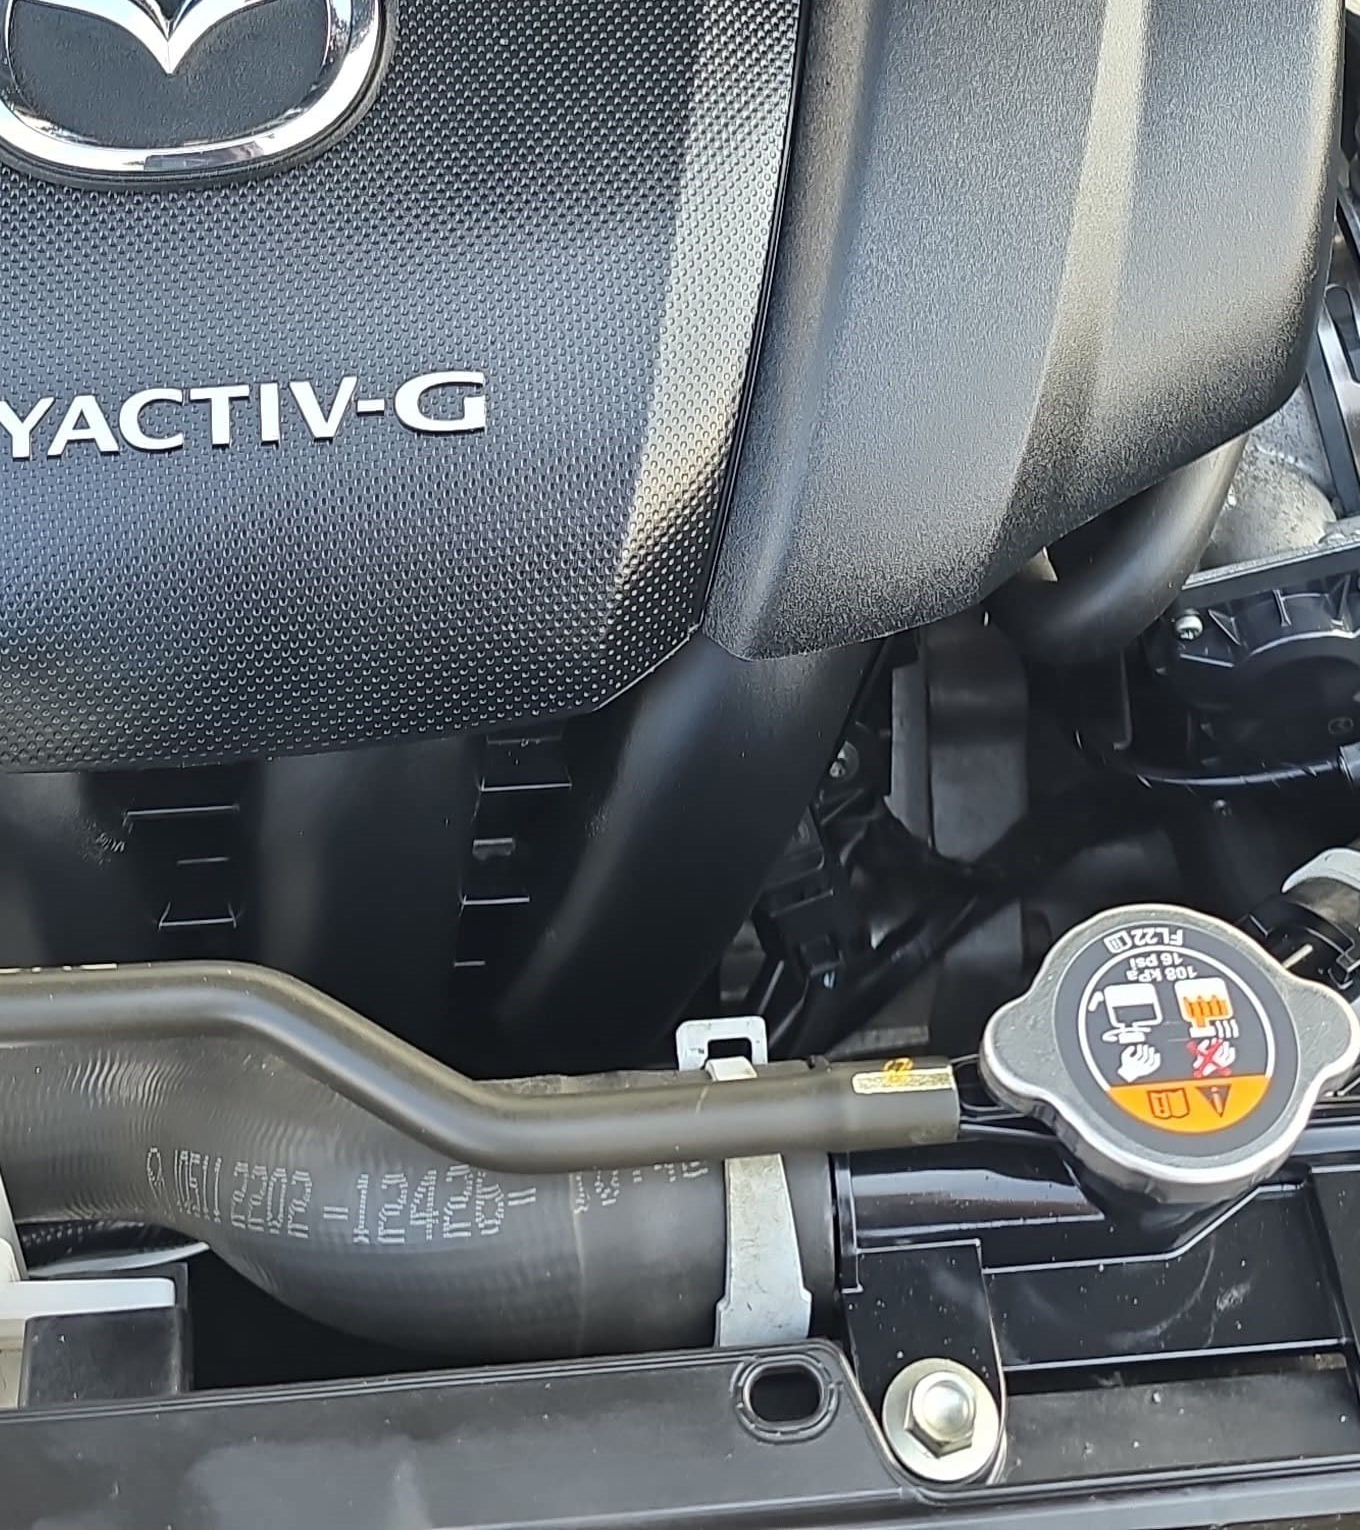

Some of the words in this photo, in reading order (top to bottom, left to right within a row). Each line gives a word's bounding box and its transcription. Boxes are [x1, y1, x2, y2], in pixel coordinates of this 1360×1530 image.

[1131, 927, 1184, 946] FL22
[1129, 953, 1159, 971] psi
[1160, 952, 1184, 967] 16
[1126, 968, 1162, 983] kPa
[1164, 965, 1198, 981] 108
